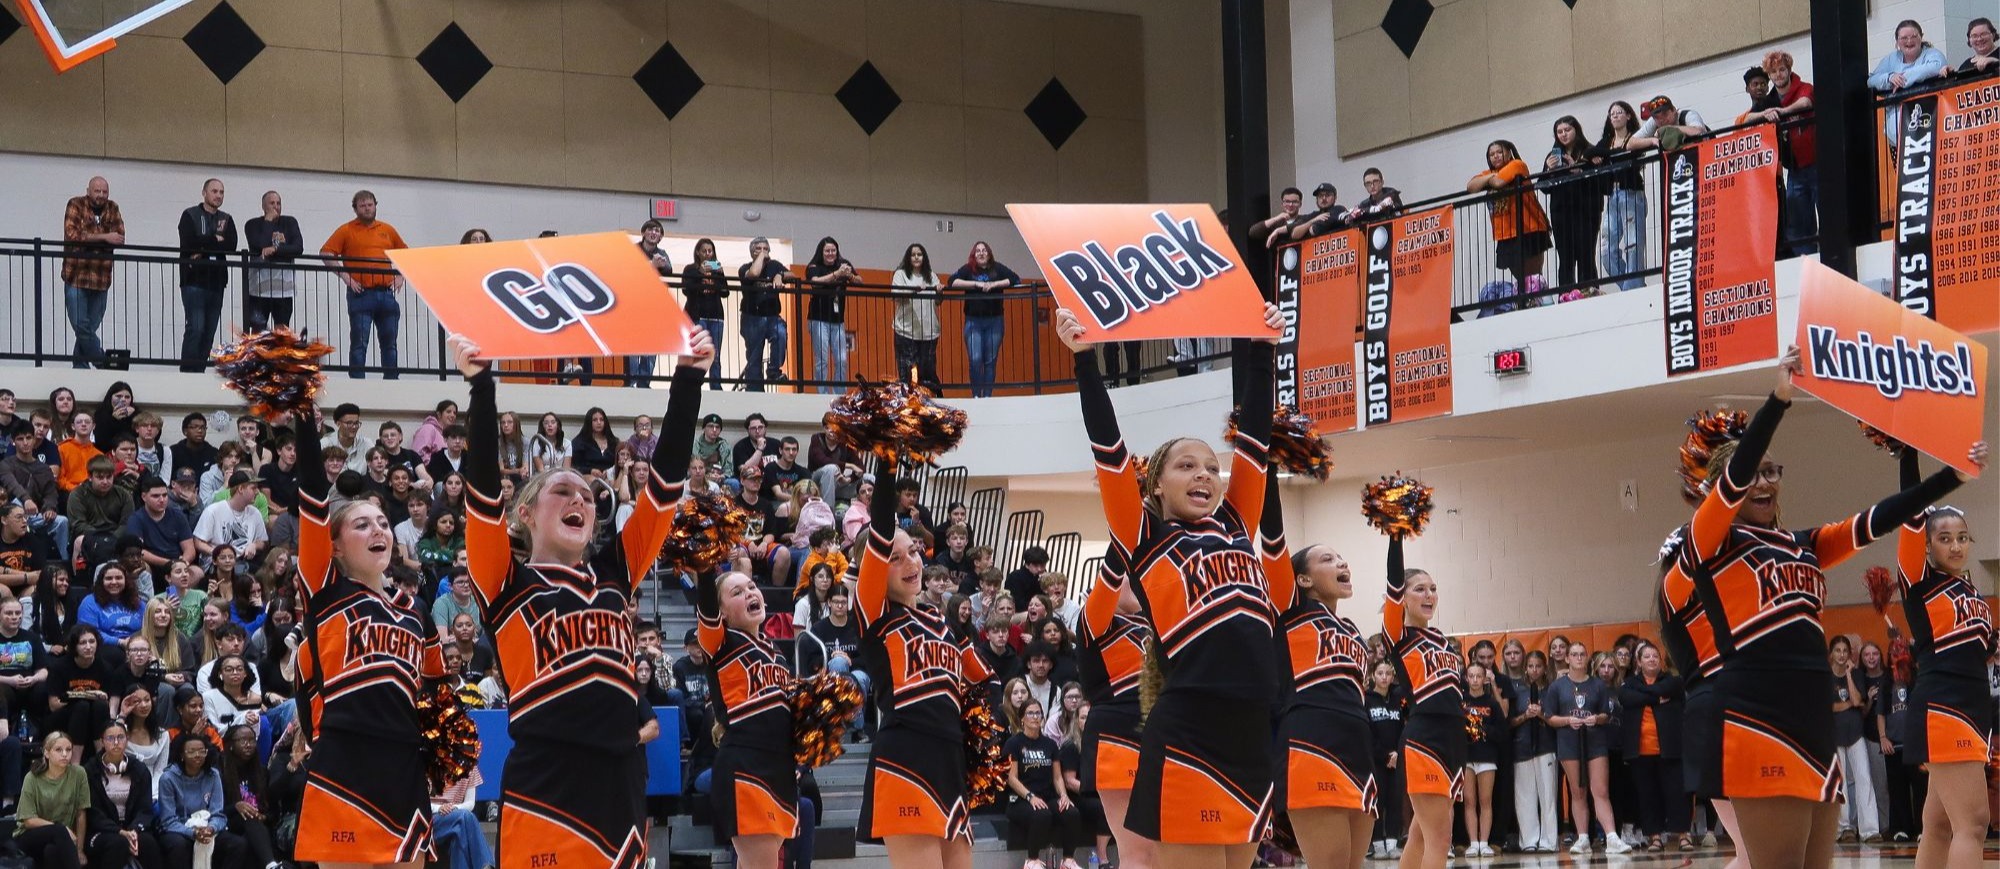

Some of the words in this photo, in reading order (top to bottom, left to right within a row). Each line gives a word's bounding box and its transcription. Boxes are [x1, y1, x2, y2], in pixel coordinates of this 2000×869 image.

[1956, 84, 2000, 110] LEAGU
[1944, 106, 2000, 133] CHAMPI
[1715, 133, 1761, 159] LEAGUE
[1940, 137, 1959, 150] 1957
[1964, 133, 1984, 146] 1958
[1986, 129, 2000, 142] 195
[1705, 150, 1773, 180] CHAMPIONS
[1939, 152, 1959, 166] 1961
[1963, 148, 1982, 161] 1962
[1985, 144, 2000, 157] 196
[1939, 167, 1958, 181] 1965
[1962, 163, 1981, 176] 1967
[1900, 131, 1931, 243] TRACK
[1938, 182, 1957, 196] 1970
[1962, 179, 1980, 192] 1971
[656, 199, 676, 216] EXIT
[1671, 178, 1694, 244] TRACK
[1938, 198, 1957, 211] 1975
[1961, 193, 1979, 207] 1976
[1406, 214, 1440, 235] LEAGUE
[1701, 209, 1715, 222] 2012
[1937, 212, 1956, 226] 1980
[1959, 209, 1978, 222] 1983
[1981, 204, 2000, 218] 1984
[1701, 223, 1715, 235] 2013
[1936, 228, 1954, 241] 1986
[1958, 224, 1977, 237] 1987
[1980, 220, 2000, 233] 1988
[1314, 235, 1348, 256] LEAGUE
[1397, 227, 1450, 254] CHAMPIONS
[1700, 237, 1715, 249] 2014
[1936, 243, 1954, 257] 1990
[1958, 239, 1977, 253] 1991
[1981, 235, 2000, 249] 1992
[1305, 250, 1355, 273] CHAMPIONS
[1700, 251, 1714, 263] 2015
[1937, 259, 1955, 272] 1994
[1959, 255, 1977, 268] 1997
[1981, 250, 2000, 264] 1998
[1050, 209, 1233, 329] Black
[1699, 265, 1714, 276] 2016
[1937, 274, 1956, 287] 2005
[1960, 270, 1978, 284] 2012
[1669, 247, 1692, 316] INDOOR
[1699, 278, 1714, 290] 2017
[1900, 253, 1929, 316] OYS
[1367, 255, 1389, 330] GOLF
[1704, 279, 1770, 307] SECTIONAL
[1704, 298, 1772, 327] CHAMPIONS
[1670, 319, 1694, 370] BOYS
[1702, 341, 1717, 354] 1991
[1395, 344, 1447, 367] SECTIONAL
[1702, 356, 1718, 368] 1992
[1807, 324, 1976, 398] Knights!
[1278, 353, 1296, 406] RLS
[1303, 362, 1352, 384] SECTIONAL
[1368, 340, 1387, 422] BOYS
[1395, 361, 1448, 385] CHAMPIONS
[1303, 379, 1354, 400] CHAMPIONS
[1625, 484, 1633, 497] A
[531, 607, 636, 678] KNIGHTS
[1956, 739, 1973, 748] RFA
[1425, 774, 1439, 782] RFA
[1761, 765, 1785, 777] RFA
[1317, 782, 1337, 791] RFA
[899, 806, 921, 817] RFA
[1200, 810, 1221, 822] RFA
[331, 831, 355, 843] RFA
[531, 852, 558, 868] RFA
